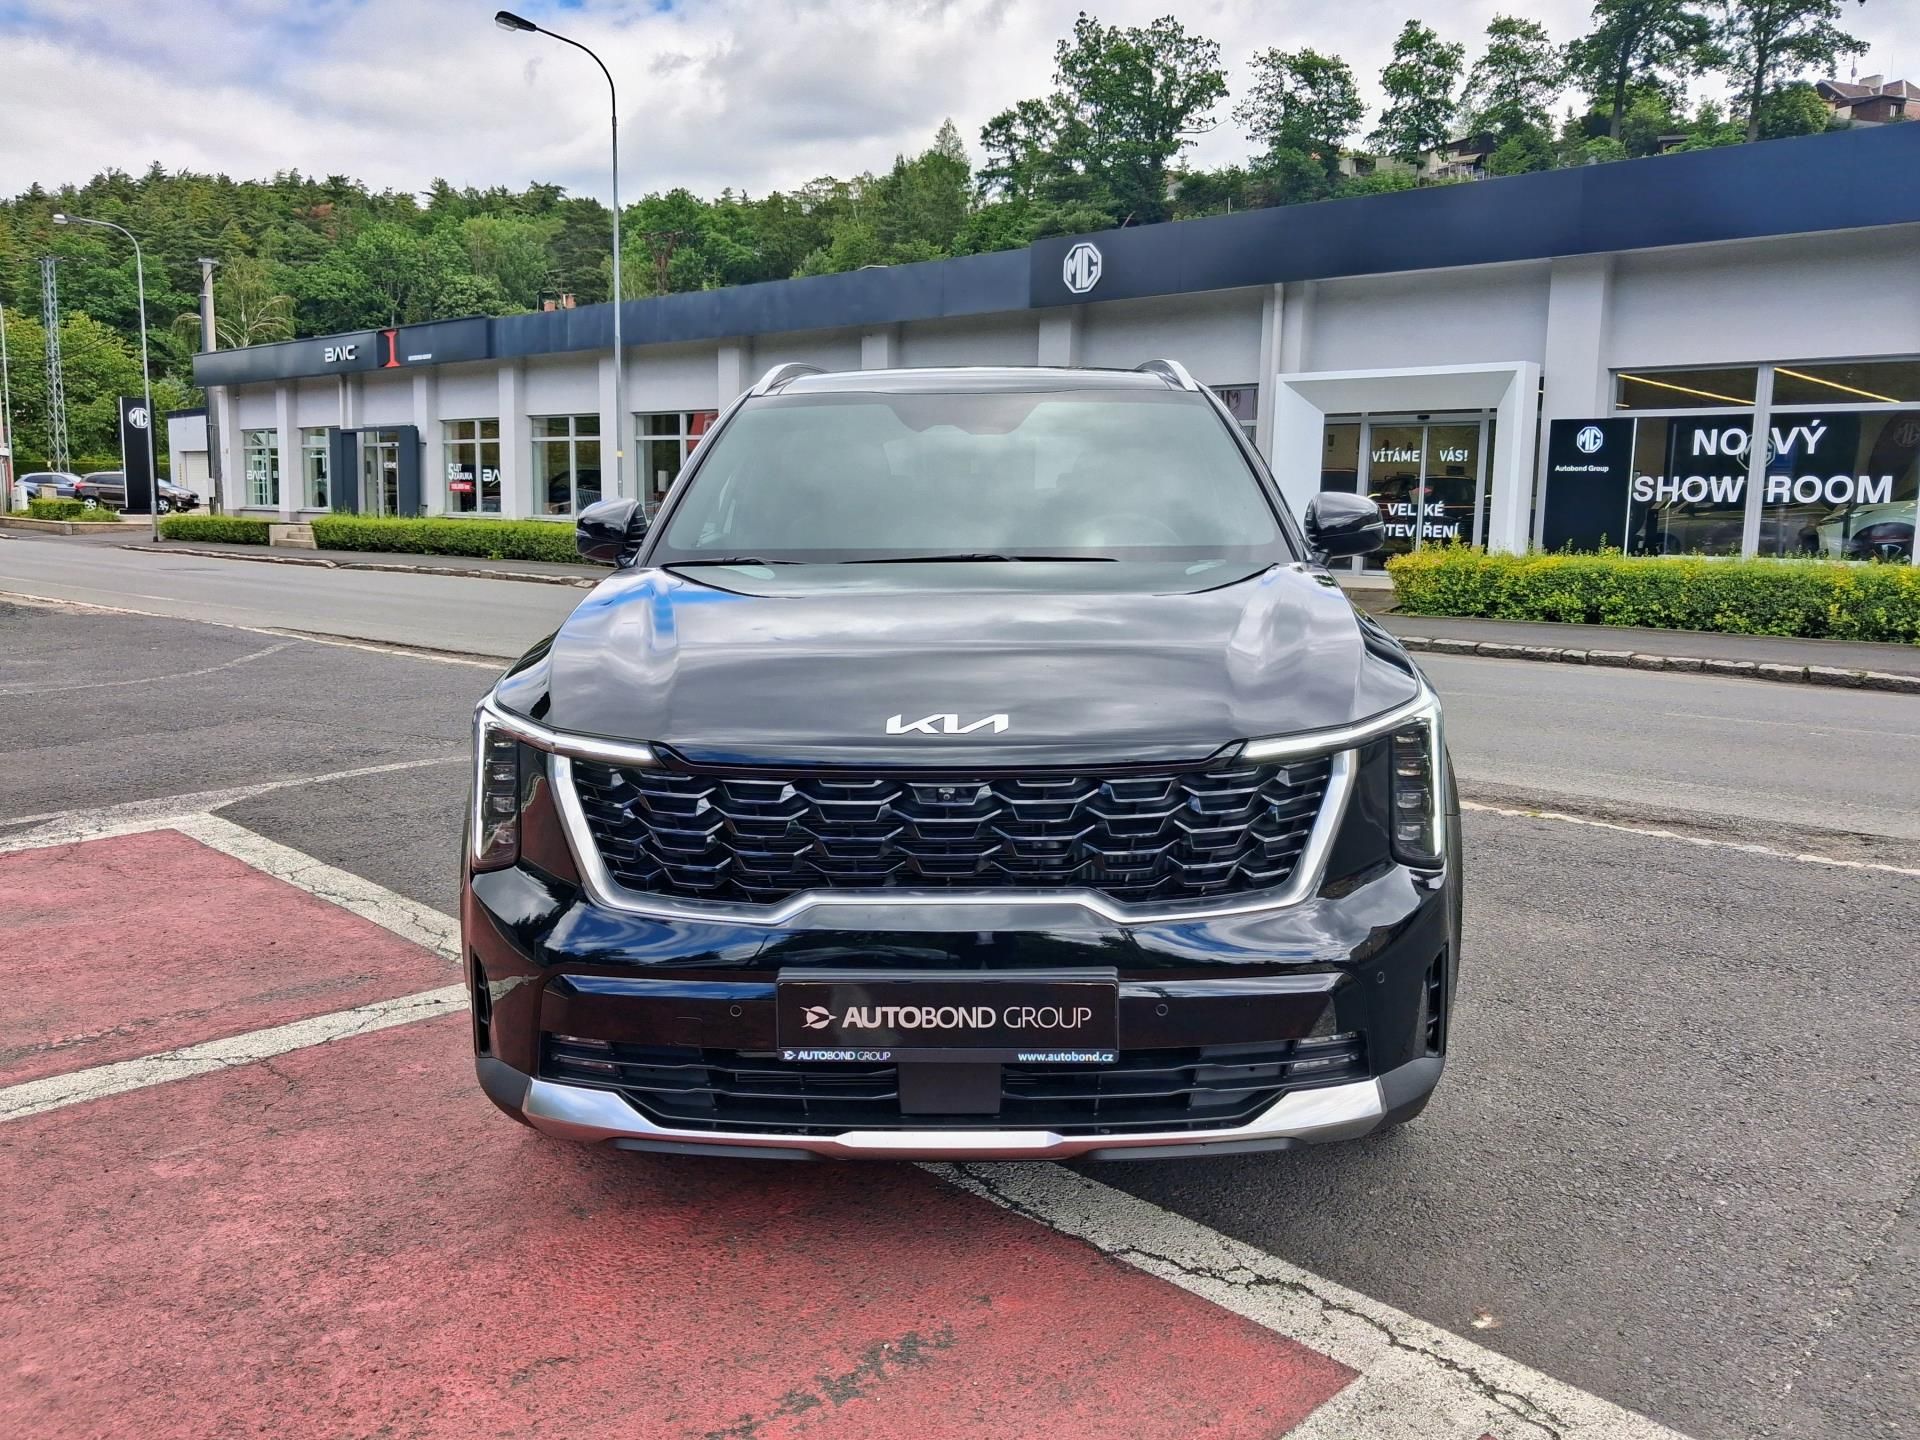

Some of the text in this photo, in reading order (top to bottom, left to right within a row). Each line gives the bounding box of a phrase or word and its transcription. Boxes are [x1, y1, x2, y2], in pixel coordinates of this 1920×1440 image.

[1065, 245, 1100, 291] MG
[130, 408, 149, 427] MG
[1578, 428, 1602, 452] MG
[1372, 446, 1468, 462] VÍTÁME VÁS!
[1588, 465, 1609, 473] Group
[1383, 522, 1460, 538] TEVŘENÍ
[886, 714, 1009, 735] KIA
[841, 1006, 1092, 1028] AUTOBOND GROUP
[798, 1050, 891, 1061] AUTOBOND GROUP
[1018, 1051, 1114, 1062] www.autobond.cz
